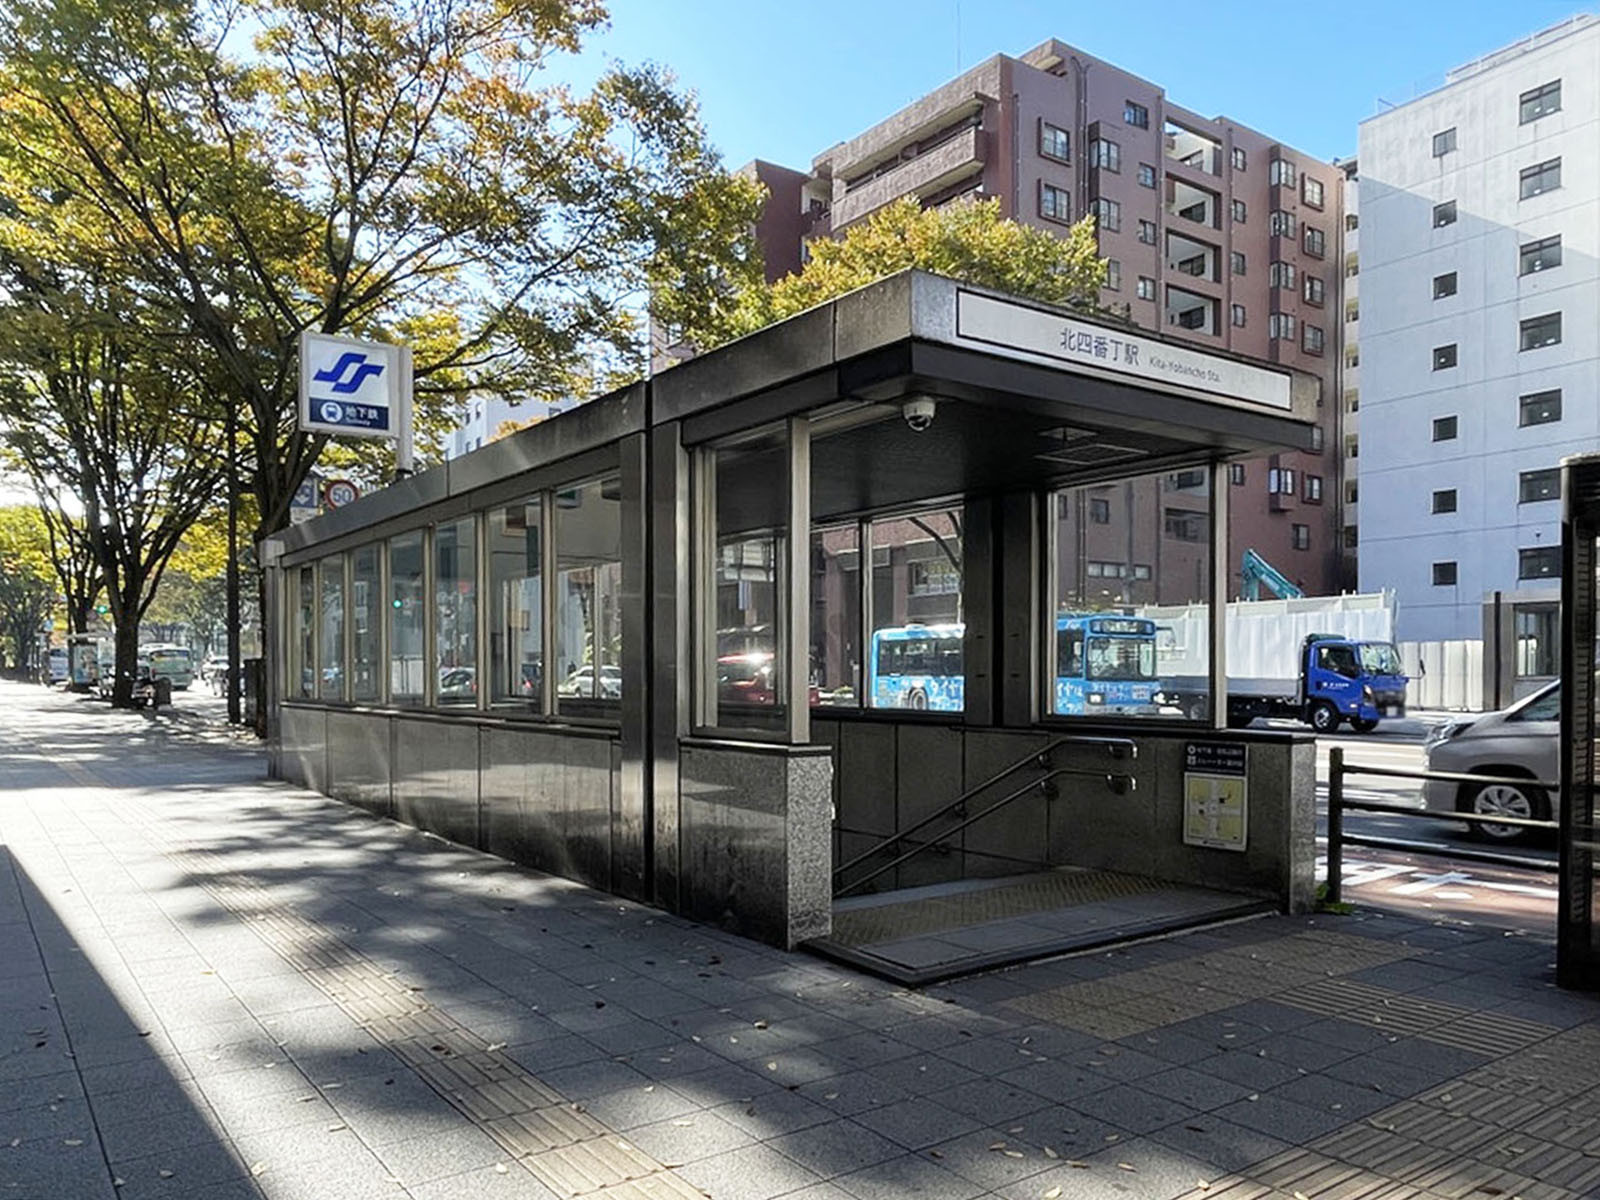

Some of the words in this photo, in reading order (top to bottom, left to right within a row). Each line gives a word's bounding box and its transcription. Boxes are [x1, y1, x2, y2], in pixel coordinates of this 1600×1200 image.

[1060, 327, 1139, 365] 北四番丁駅
[346, 405, 379, 420] 地下鉄
[333, 488, 352, 503] 50
